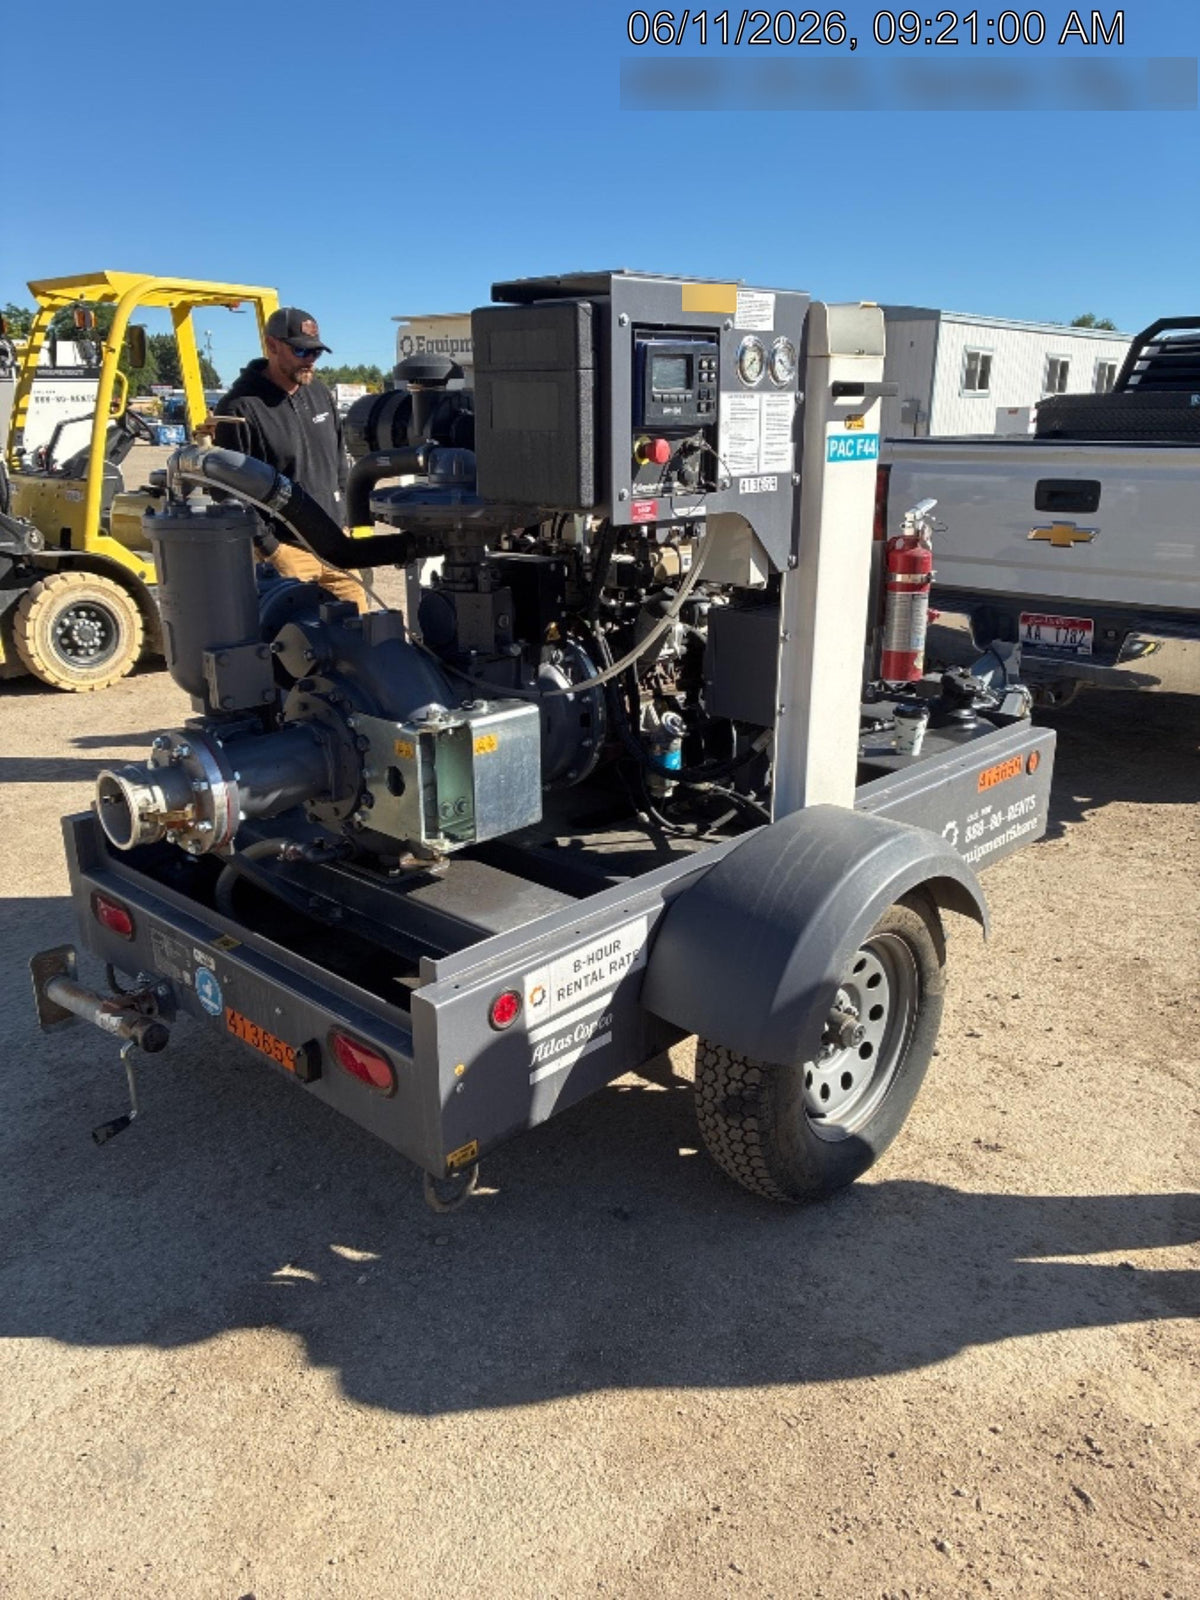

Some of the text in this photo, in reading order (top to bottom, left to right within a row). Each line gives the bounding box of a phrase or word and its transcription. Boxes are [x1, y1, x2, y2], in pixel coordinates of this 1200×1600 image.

[830, 438, 876, 458] PAC F44
[557, 949, 640, 1001] RENTAL RATE
[228, 1010, 297, 1063] 413659
[529, 1013, 614, 1067] Atlas Copco
